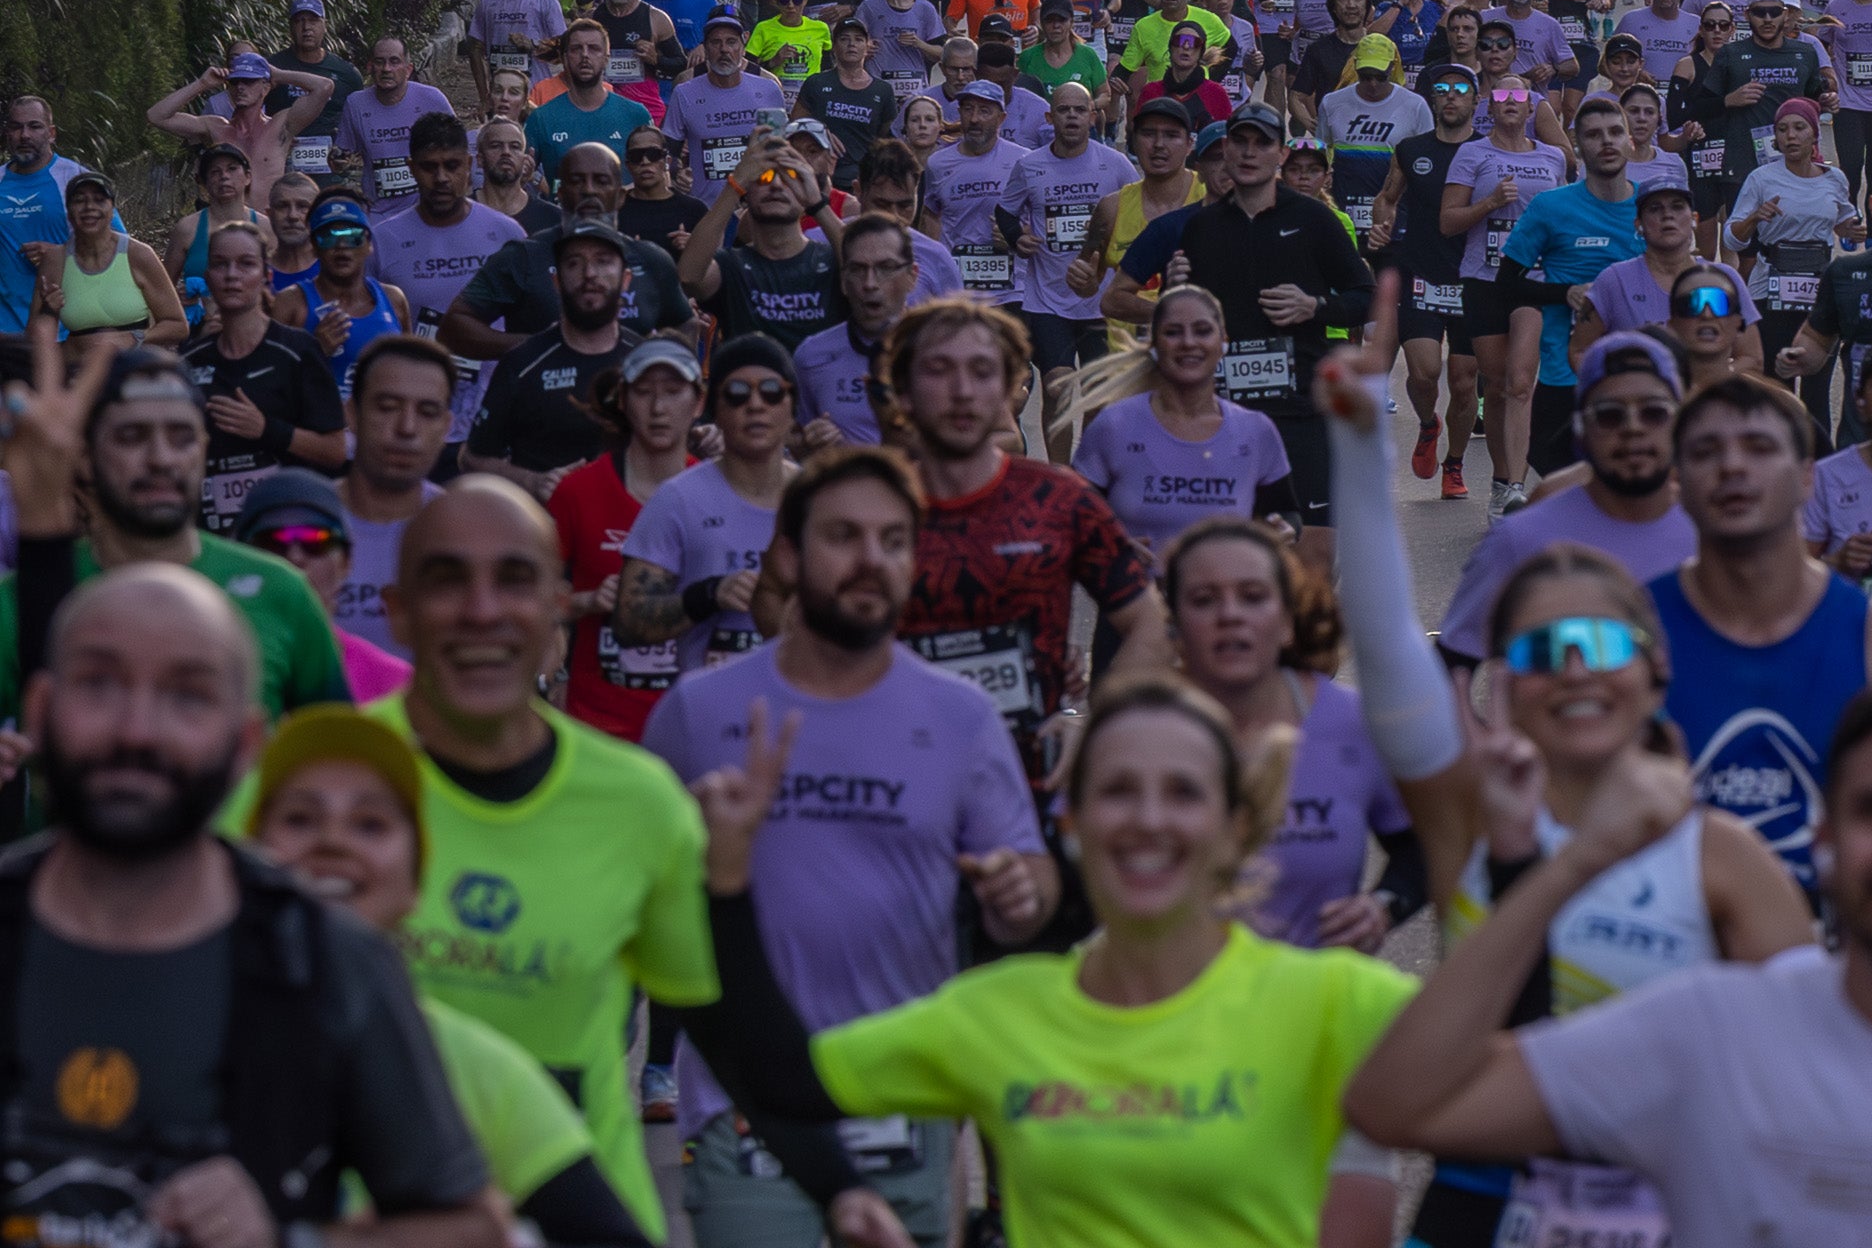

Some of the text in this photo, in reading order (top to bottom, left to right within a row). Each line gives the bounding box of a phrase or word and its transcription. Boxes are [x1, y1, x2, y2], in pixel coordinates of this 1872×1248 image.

[1757, 68, 1797, 78] SPCITY
[831, 101, 873, 116] SPCITY
[1346, 114, 1396, 143] fun
[1506, 163, 1551, 177] SPCITY
[956, 181, 1001, 194] SPCITY
[1053, 182, 1100, 196] SPCITY
[426, 254, 486, 271] SPCITY
[965, 259, 1006, 272] 13395
[760, 291, 821, 309] SPCITY
[1231, 358, 1285, 379] 10945
[1160, 475, 1237, 495] SPCITY
